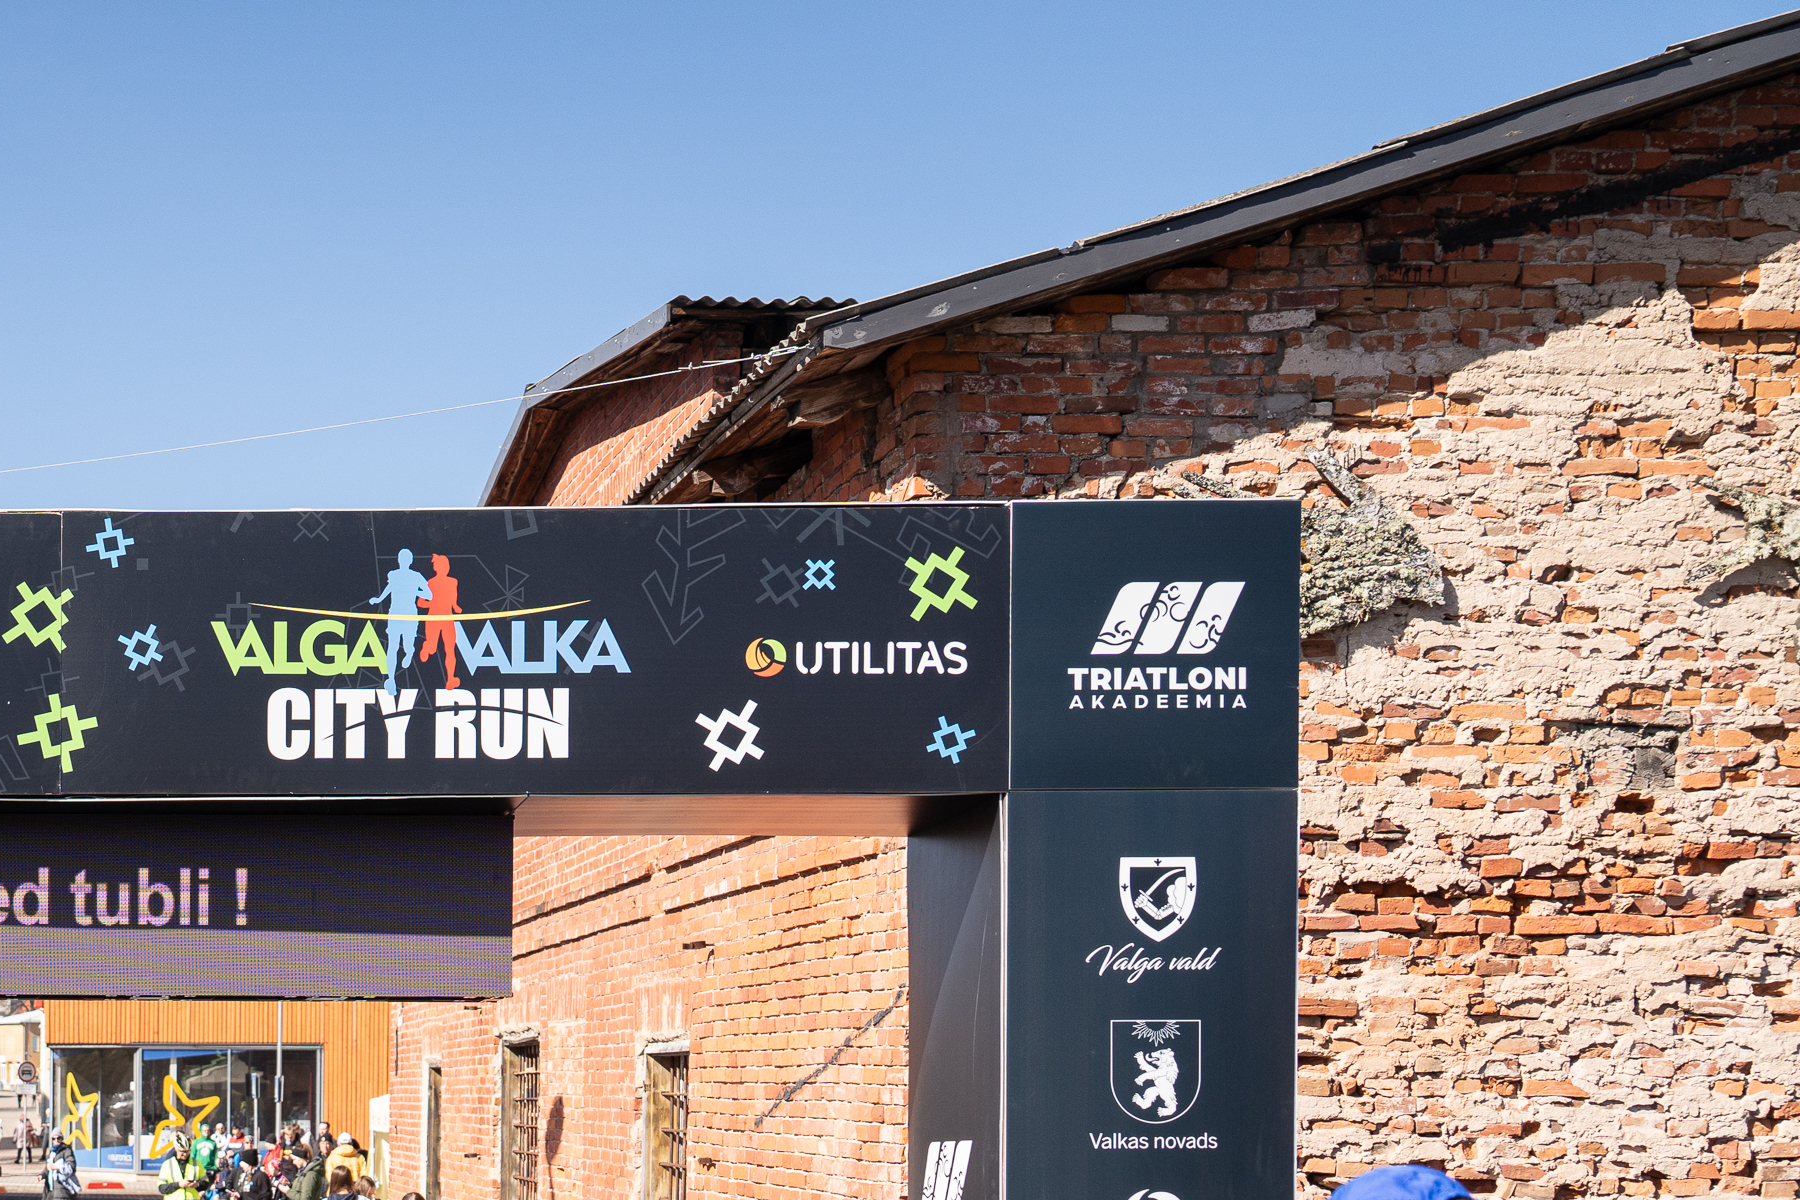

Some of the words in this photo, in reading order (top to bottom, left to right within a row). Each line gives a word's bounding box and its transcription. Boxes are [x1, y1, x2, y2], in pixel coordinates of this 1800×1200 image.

[211, 620, 388, 675] VALGA
[453, 620, 631, 674] VALKA
[796, 641, 968, 675] UTILITAS
[1068, 667, 1247, 691] TRIATLONI
[1069, 694, 1247, 710] AKADEEMIA
[267, 688, 413, 760] CITY
[435, 687, 569, 759] RUN
[70, 867, 211, 926] tubli
[1085, 942, 1165, 984] Valga
[1168, 947, 1222, 971] vald
[1089, 1133, 1149, 1150] Valkas
[1153, 1133, 1218, 1150] novads
